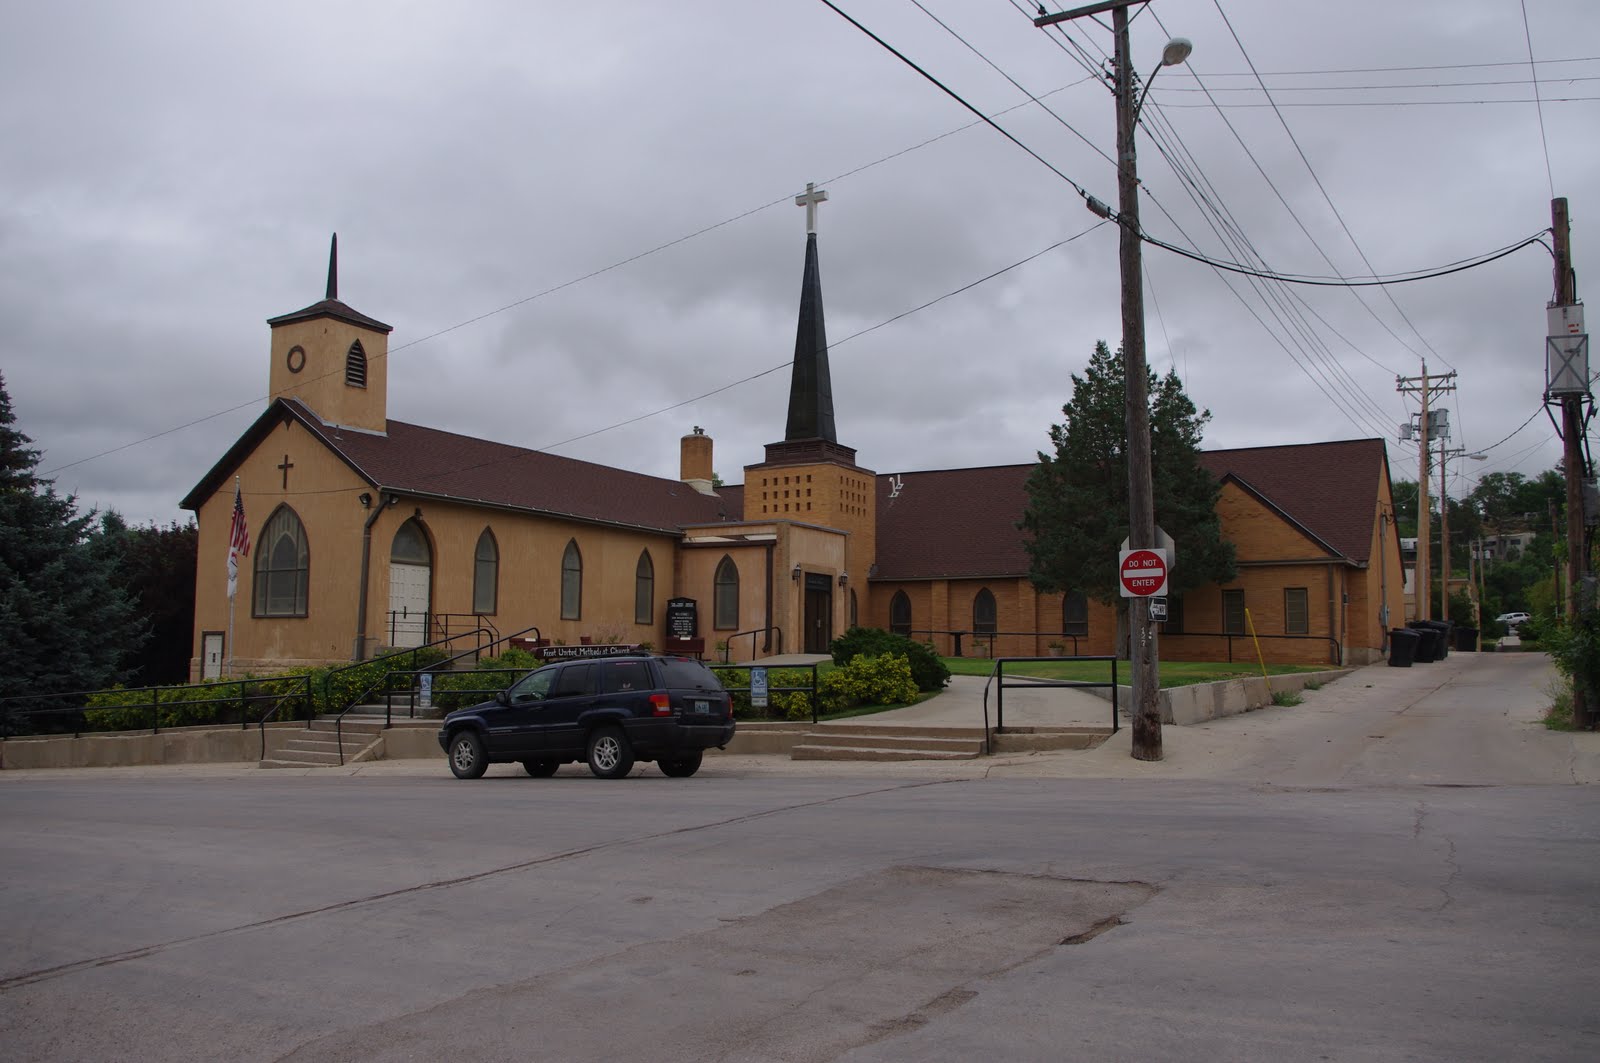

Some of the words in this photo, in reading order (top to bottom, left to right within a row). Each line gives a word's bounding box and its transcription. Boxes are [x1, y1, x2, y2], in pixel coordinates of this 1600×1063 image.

[1132, 578, 1155, 587] ENTER
[543, 648, 557, 657] First
[558, 648, 577, 657] United
[579, 647, 608, 656] Methodist
[610, 646, 630, 655] Church
